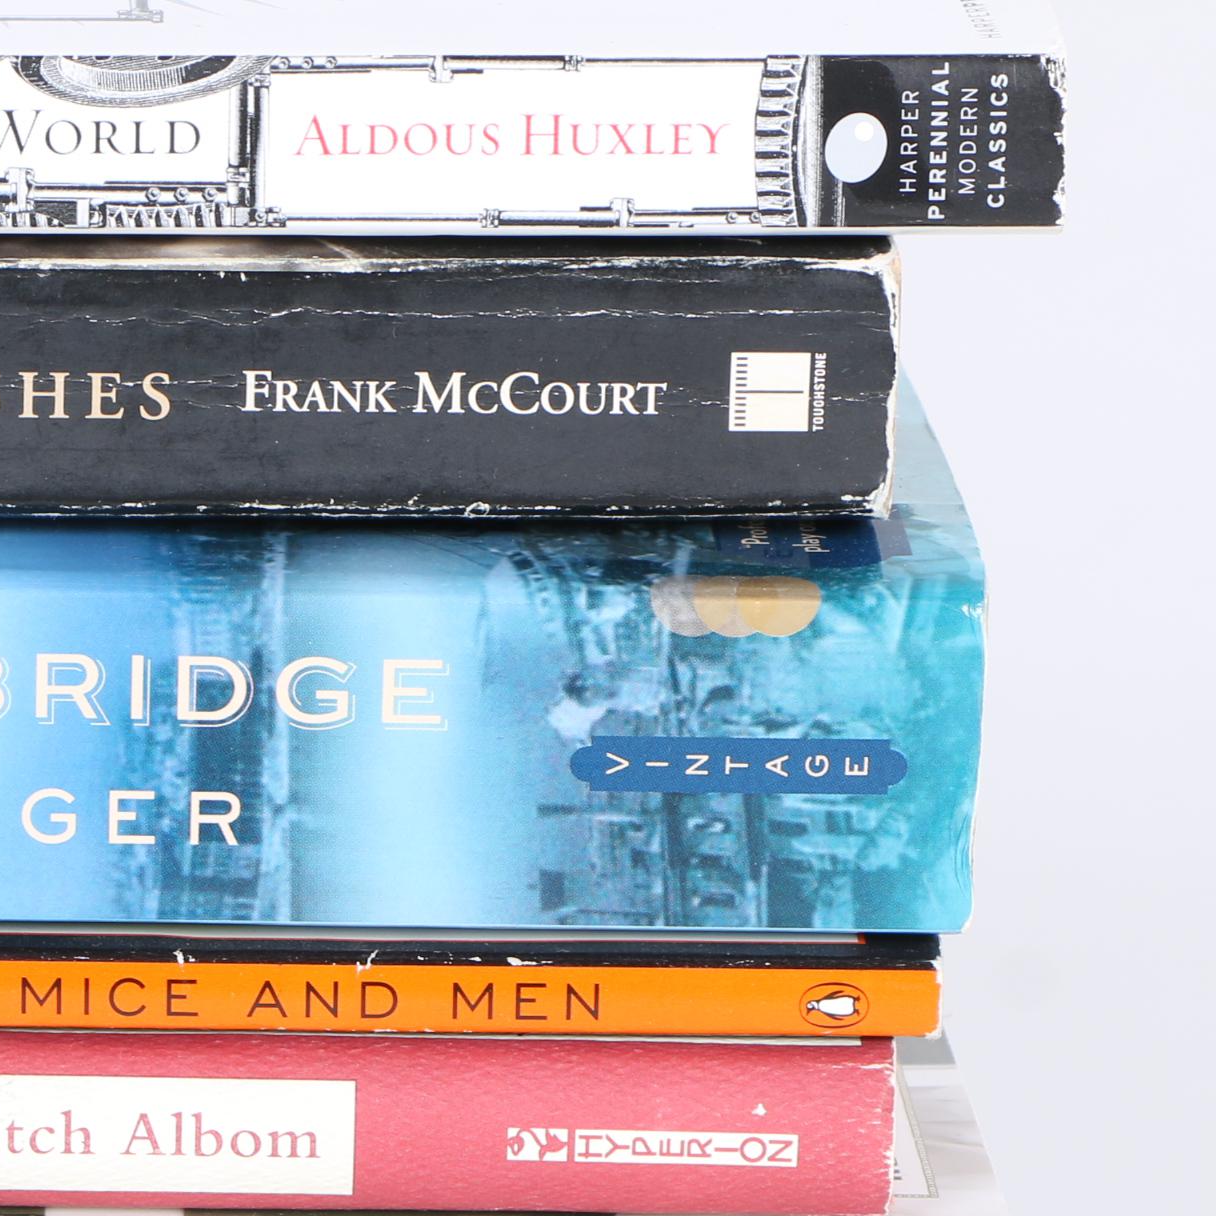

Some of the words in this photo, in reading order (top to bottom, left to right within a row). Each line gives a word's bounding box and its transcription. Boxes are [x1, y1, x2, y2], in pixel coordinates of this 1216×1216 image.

[295, 115, 500, 156] ALDOUS
[523, 113, 731, 156] HUXLEY
[899, 90, 920, 192] HARPER
[927, 61, 950, 220] PERENNIAL
[957, 88, 979, 194] MODERN
[986, 73, 1009, 208] CLASSICS
[237, 370, 397, 413] FRANK
[812, 352, 827, 432] TOUCHSTONE
[605, 752, 869, 778] VINTAGE
[21, 976, 199, 1017] MICE
[247, 980, 398, 1019] AND
[452, 982, 600, 1021] MEN
[119, 1111, 321, 1159] Albom
[577, 1133, 793, 1164] HYPERION
